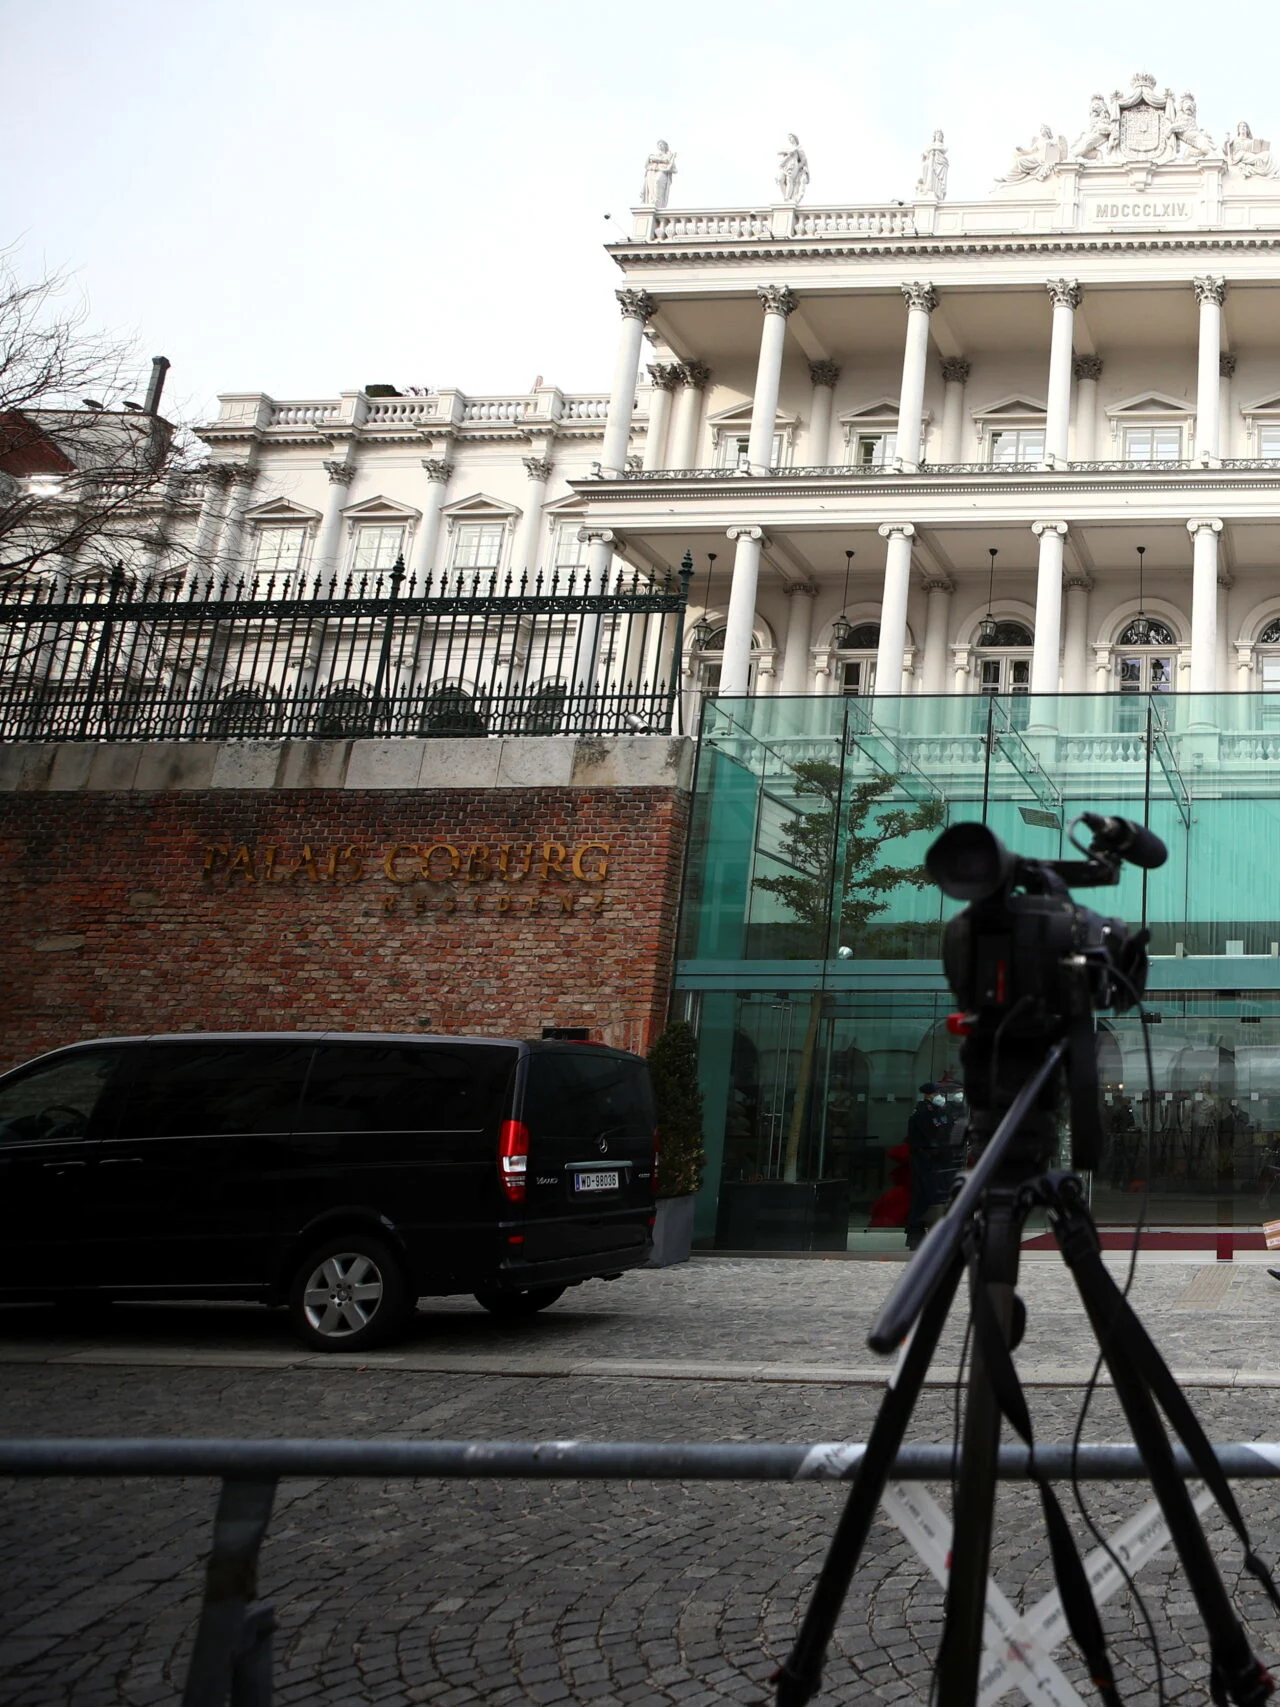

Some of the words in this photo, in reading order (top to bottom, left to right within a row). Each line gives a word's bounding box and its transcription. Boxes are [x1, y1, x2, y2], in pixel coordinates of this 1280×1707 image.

[203, 844, 366, 882] PALAIS
[383, 843, 611, 882] COBURG
[382, 894, 607, 912] RESIDENZ
